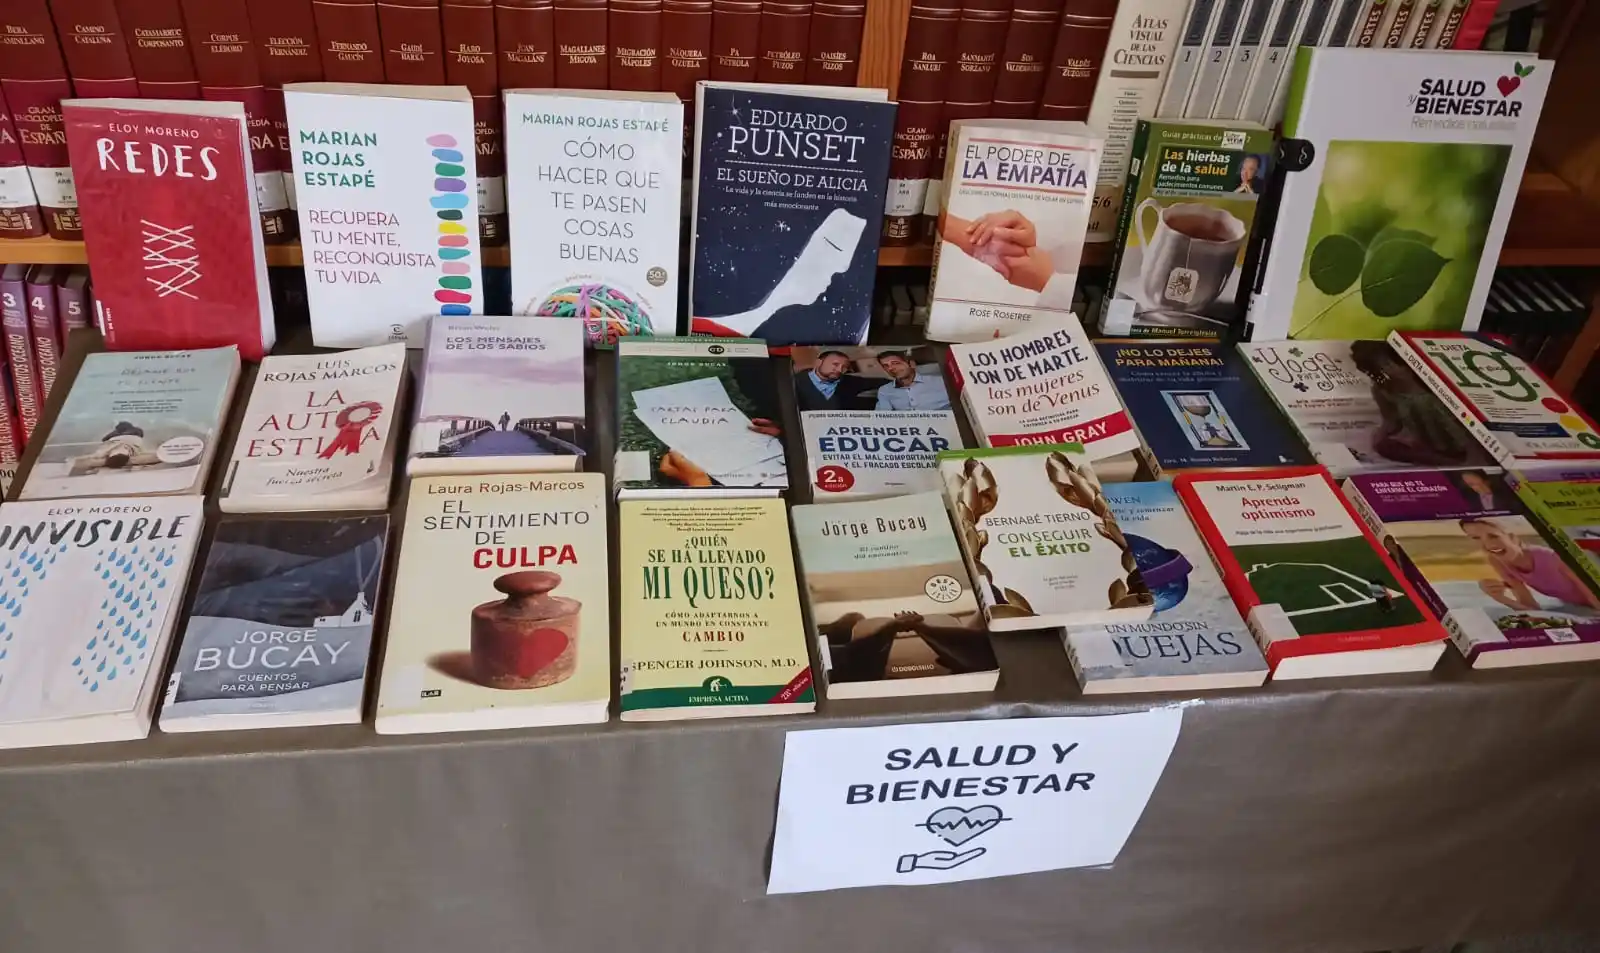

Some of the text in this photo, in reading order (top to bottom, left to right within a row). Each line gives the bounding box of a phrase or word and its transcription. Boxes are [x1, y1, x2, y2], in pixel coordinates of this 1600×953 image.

[1132, 14, 1168, 30] ATLAS
[1130, 31, 1163, 41] VISUAL
[331, 41, 367, 51] FERNANDO
[1143, 44, 1156, 52] LAS
[1114, 48, 1166, 65] CIENCIAS
[1184, 51, 1191, 62] 1
[1213, 51, 1223, 62] 2
[1240, 51, 1250, 62] 3
[1268, 51, 1277, 63] 4
[1419, 78, 1486, 97] SALUD
[1414, 97, 1522, 118] BIENESTAR
[522, 113, 669, 132] MARIAN ROJAS ESTAPÉ
[750, 108, 848, 132] EDUARDO
[109, 122, 200, 139] ELOY MORENO
[300, 129, 377, 146] MARIAN
[1181, 131, 1211, 142] prácticas
[1213, 133, 1222, 141] de
[563, 136, 634, 160] CÓMO
[728, 125, 865, 163] PUNSET
[96, 137, 220, 181] REDES
[302, 150, 364, 167] ROJAS
[892, 145, 931, 160] ESPAÑA
[965, 144, 1071, 167] EL PODER DE
[1164, 149, 1231, 163] Las hierbas
[962, 160, 1088, 189] LA EMPATÍA
[1161, 161, 1229, 176] de la salud
[304, 169, 375, 188] ESTAPÉ
[538, 165, 660, 189] HACER QUE
[717, 168, 868, 192] EL SUEÑO DE ALICIA
[551, 191, 646, 214] TE PASEN
[309, 209, 400, 226] RECUPERA
[564, 218, 634, 239] COSAS
[311, 229, 401, 247] TU MENTE,
[313, 250, 436, 268] RECONQUISTA
[560, 243, 639, 264] BUENAS
[315, 269, 381, 284] TU VIDA
[2, 292, 17, 308] 3
[31, 296, 46, 311] 4
[68, 301, 81, 316] 5
[970, 307, 991, 318] ROSE
[968, 329, 1072, 367] LOS HOMBRES
[1117, 348, 1213, 357] ¡NO LO DEJES
[316, 359, 351, 370] LUIS
[969, 346, 1089, 385] SON DE MARTE.
[1115, 356, 1224, 367] PARA MAÑANA!
[1253, 346, 1342, 391] Yoga
[264, 363, 398, 383] ROJAS MARCOS
[988, 369, 1084, 400] las mujeres
[306, 389, 346, 408] LA
[988, 383, 1100, 416] son de Venus
[826, 426, 939, 436] APRENDER A
[1062, 421, 1108, 444] GRAY
[818, 437, 950, 453] EDUCAR
[286, 467, 330, 477] Nuestra
[428, 481, 585, 494] Laura Rojas-Marcos
[1266, 482, 1306, 492] Seligman
[48, 505, 152, 516] ELOY MORENO
[443, 500, 471, 514] EL
[1241, 496, 1300, 509] Aprenda
[423, 511, 590, 530] SENTIMIENTO
[985, 511, 1091, 527] BERNABÉ TIERNO
[1241, 508, 1316, 521] optimismo
[0, 515, 191, 550] INVISIBLE
[821, 516, 928, 538] Jorge Bucay
[475, 531, 506, 545] DE
[685, 534, 728, 549] ¿QUIÉN
[997, 528, 1092, 545] CONSEGUIR
[473, 544, 578, 569] CULPA
[648, 549, 766, 564] SE HA LLEVADO
[1009, 542, 1091, 558] EL ÉXITO
[642, 566, 775, 609] MI QUESO?
[665, 611, 691, 619] CÓMO
[1104, 621, 1209, 634] UN MUNDO SIN
[235, 629, 318, 644] JORGE
[682, 630, 746, 642] CAMBIO
[194, 641, 351, 672] BUCAY
[698, 658, 801, 671] JOHNSON, M.D.
[238, 672, 297, 682] CUENTOS
[220, 681, 310, 692] PARA PENSAR
[884, 742, 1080, 771] SALUD Y
[846, 772, 1096, 805] BIENESTAR
